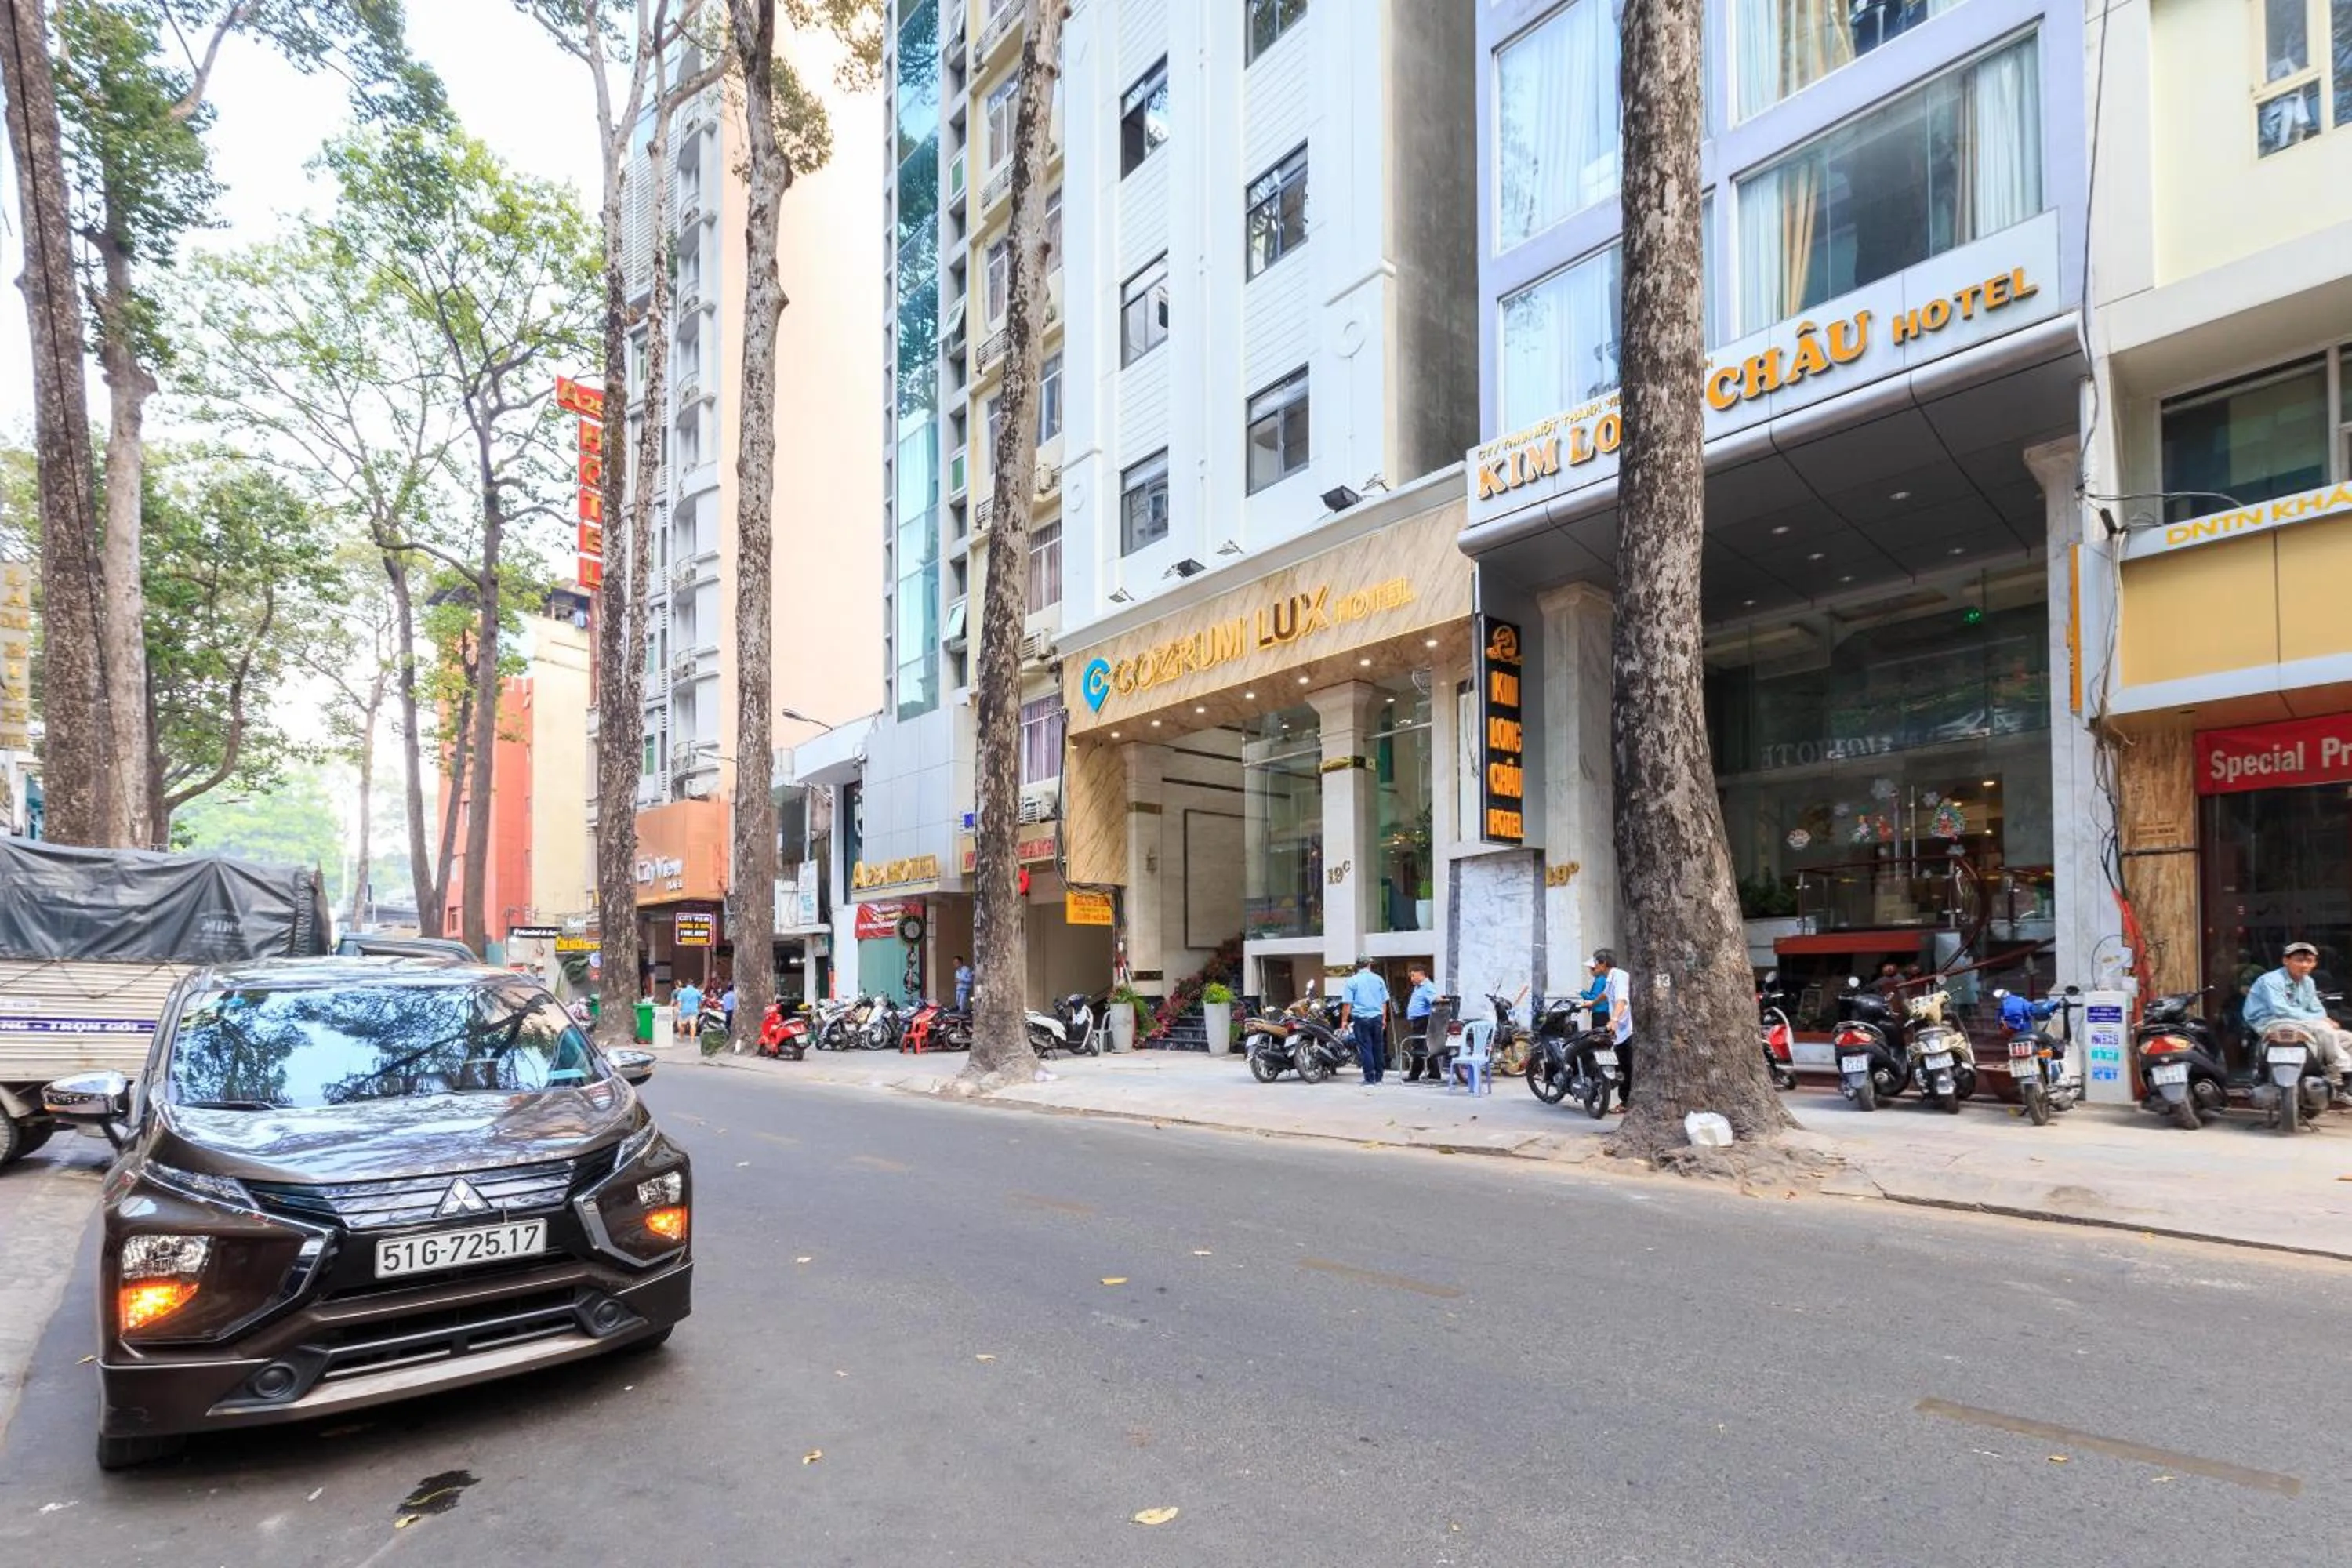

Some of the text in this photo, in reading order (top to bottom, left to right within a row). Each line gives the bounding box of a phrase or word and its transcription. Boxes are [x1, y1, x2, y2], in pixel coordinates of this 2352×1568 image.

[1705, 267, 2038, 411] CHÂU HOTEL
[1477, 413, 1622, 500] KIM LO
[2165, 506, 2264, 545] DNTN
[1256, 584, 1330, 651] LUX
[1335, 577, 1416, 624] HOTEL
[1491, 670, 1519, 707] KIM
[1490, 716, 1522, 753] LONG
[2210, 741, 2305, 783] Special
[1488, 808, 1524, 838] HOTEL
[383, 1225, 540, 1272] 51G-725.17
